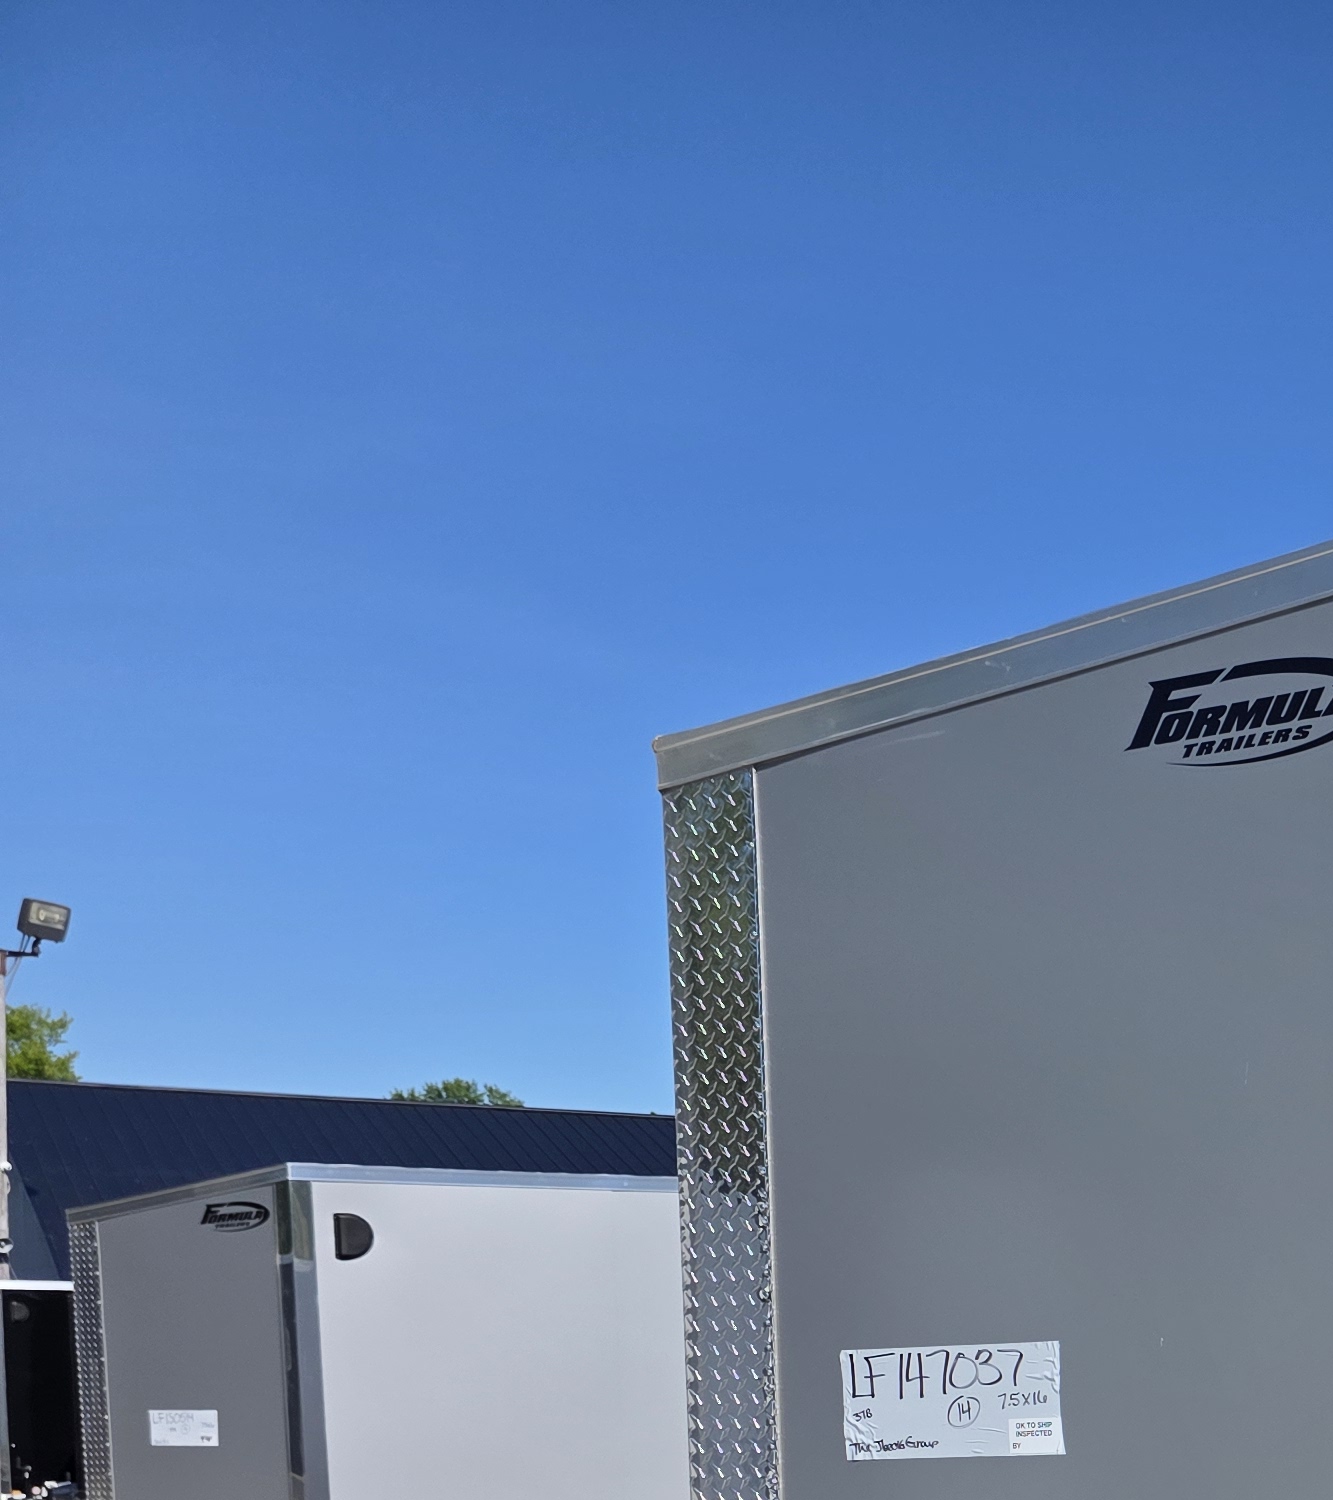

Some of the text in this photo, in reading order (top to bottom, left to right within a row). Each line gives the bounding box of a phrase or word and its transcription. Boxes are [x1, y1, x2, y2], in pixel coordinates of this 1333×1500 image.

[1182, 724, 1313, 759] TRAILERS
[848, 1349, 1024, 1400] LF147037
[1015, 1422, 1025, 1430] OK
[1027, 1421, 1036, 1429] TO
